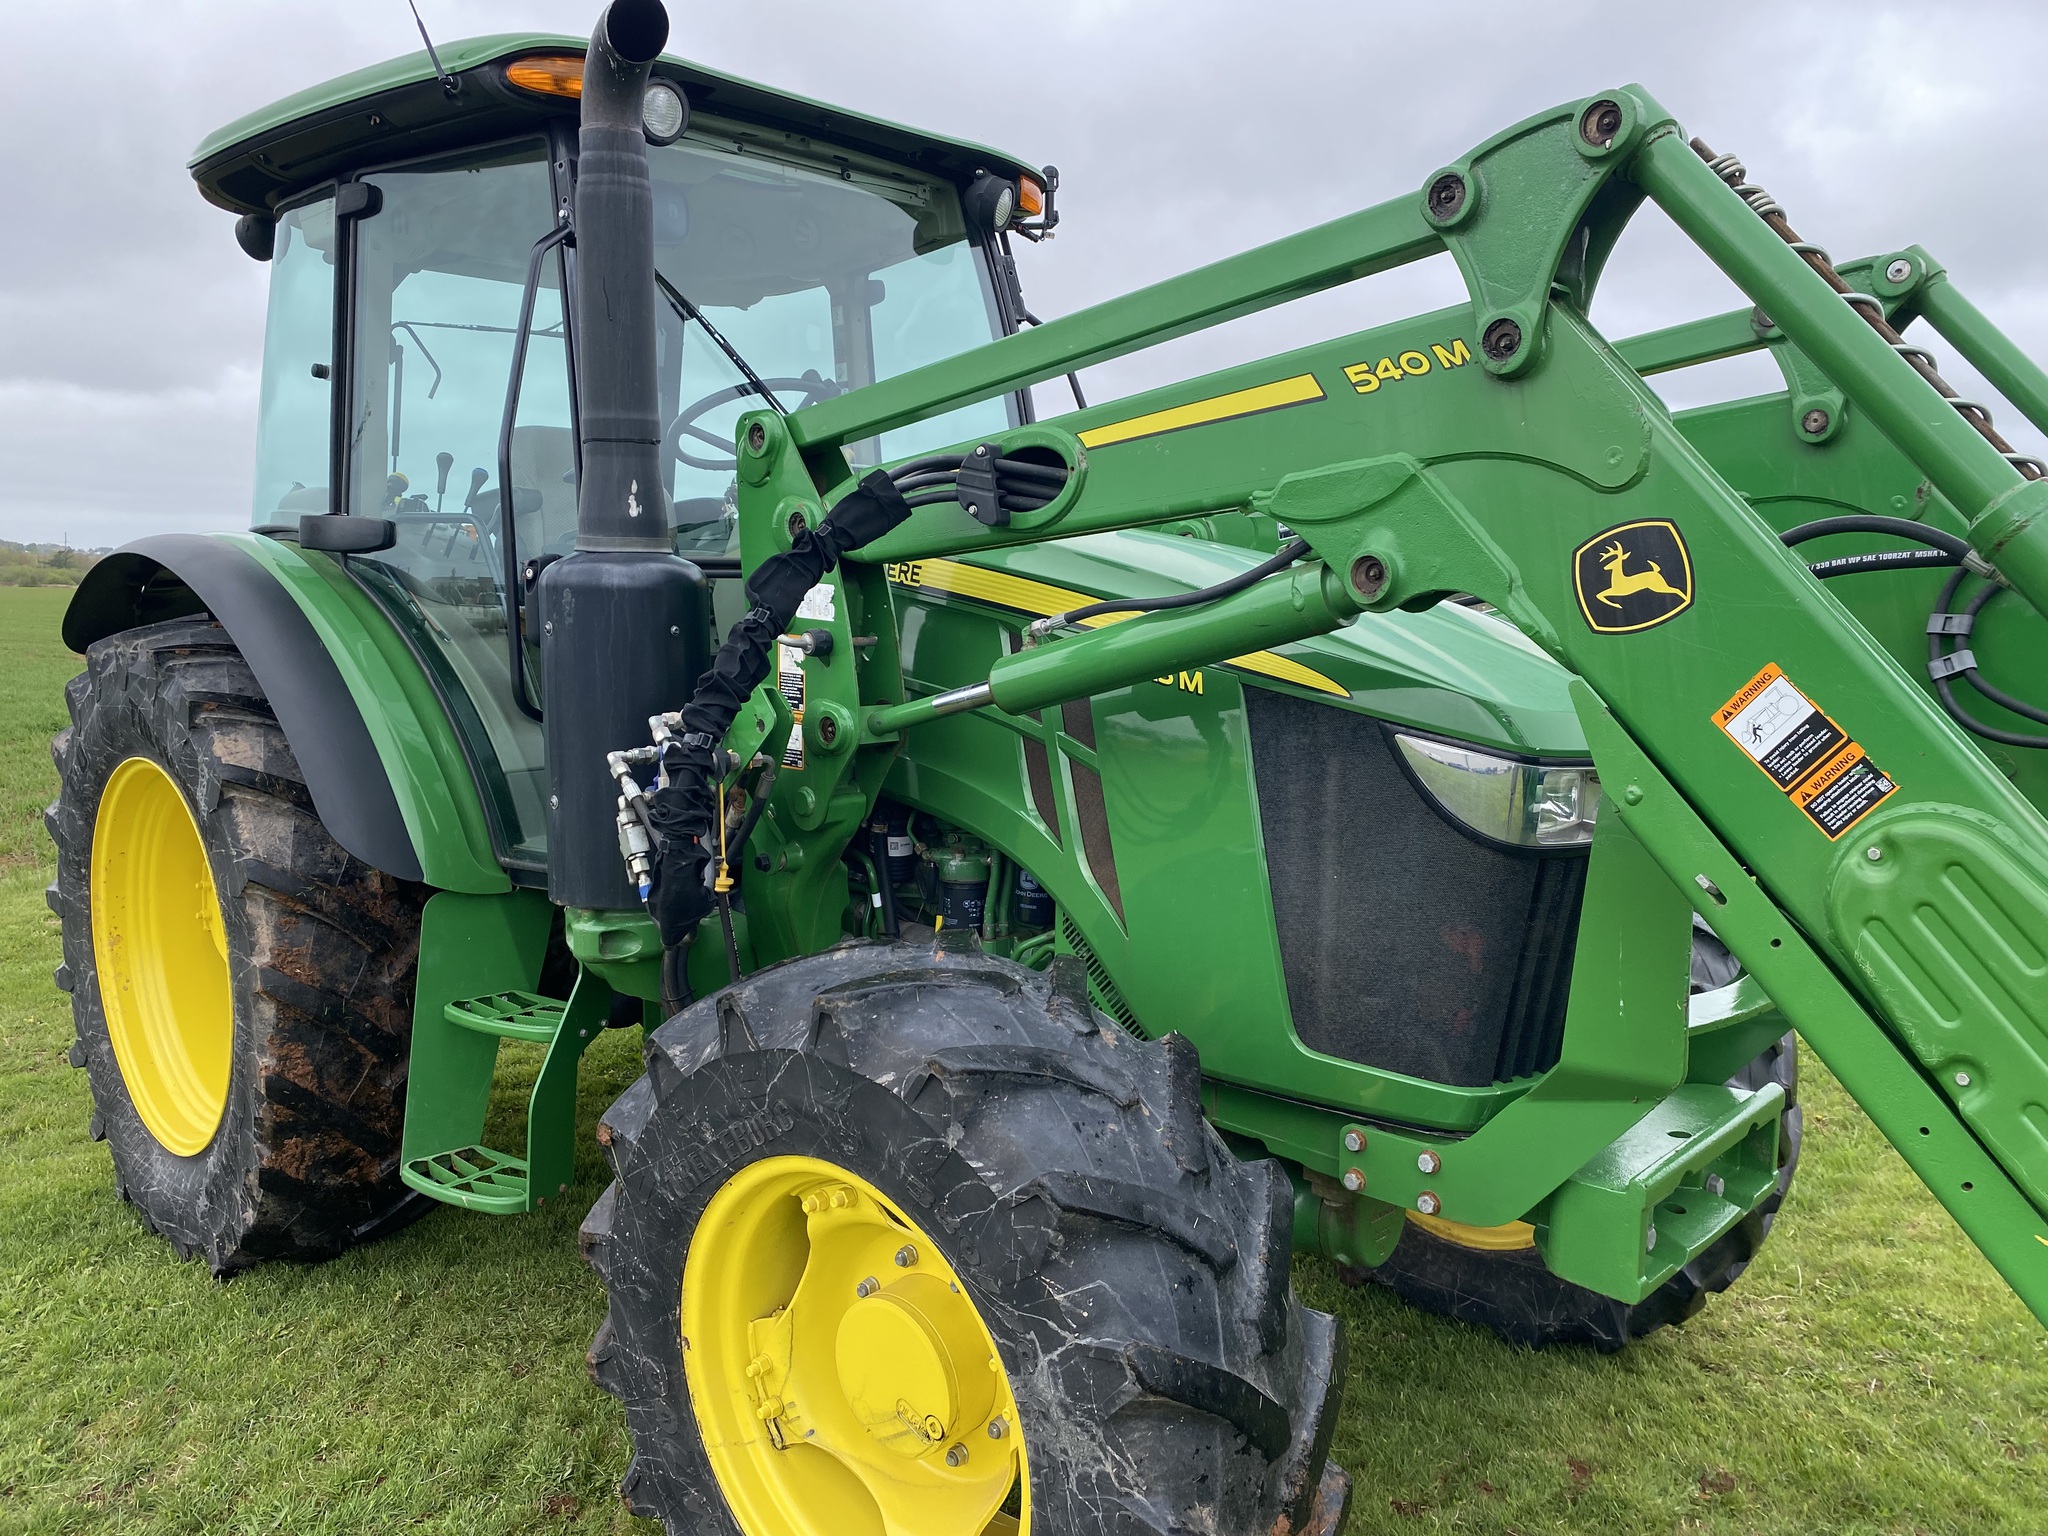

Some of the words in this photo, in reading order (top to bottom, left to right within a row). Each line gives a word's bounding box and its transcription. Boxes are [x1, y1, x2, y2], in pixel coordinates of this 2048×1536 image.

[1343, 350, 1431, 394] 540
[1815, 561, 1830, 570] 330
[1831, 558, 1847, 567] BAR
[1848, 556, 1861, 564] WP
[1862, 554, 1877, 562] SAE
[1878, 551, 1911, 560] 100R2AT
[1914, 550, 1938, 558] MSHA
[1730, 672, 1772, 711] WARNING
[1769, 750, 1780, 760] avoid
[1778, 741, 1789, 752] injury
[1788, 734, 1798, 743] from
[1796, 724, 1810, 735] falling
[1786, 750, 1795, 759] walk
[1798, 734, 1814, 748] perform
[1790, 751, 1801, 761] under
[1804, 738, 1816, 750] raised
[1821, 732, 1832, 742] when
[1810, 752, 1856, 791] WARNING
[1816, 795, 1825, 804] NOT
[1824, 784, 1839, 797] operate
[1837, 775, 1850, 786] loader
[1819, 807, 1833, 819] Failure
[1836, 793, 1850, 805] engage
[1862, 773, 1874, 783] could
[1824, 812, 1835, 822] result
[1837, 793, 1858, 811] attachment
[1857, 779, 1876, 795] detaching
[1830, 781, 1851, 799] attachment
[1827, 818, 1837, 826] from
[1835, 808, 1848, 819] loader
[1847, 797, 1862, 810] causing
[1841, 811, 1853, 821] injury
